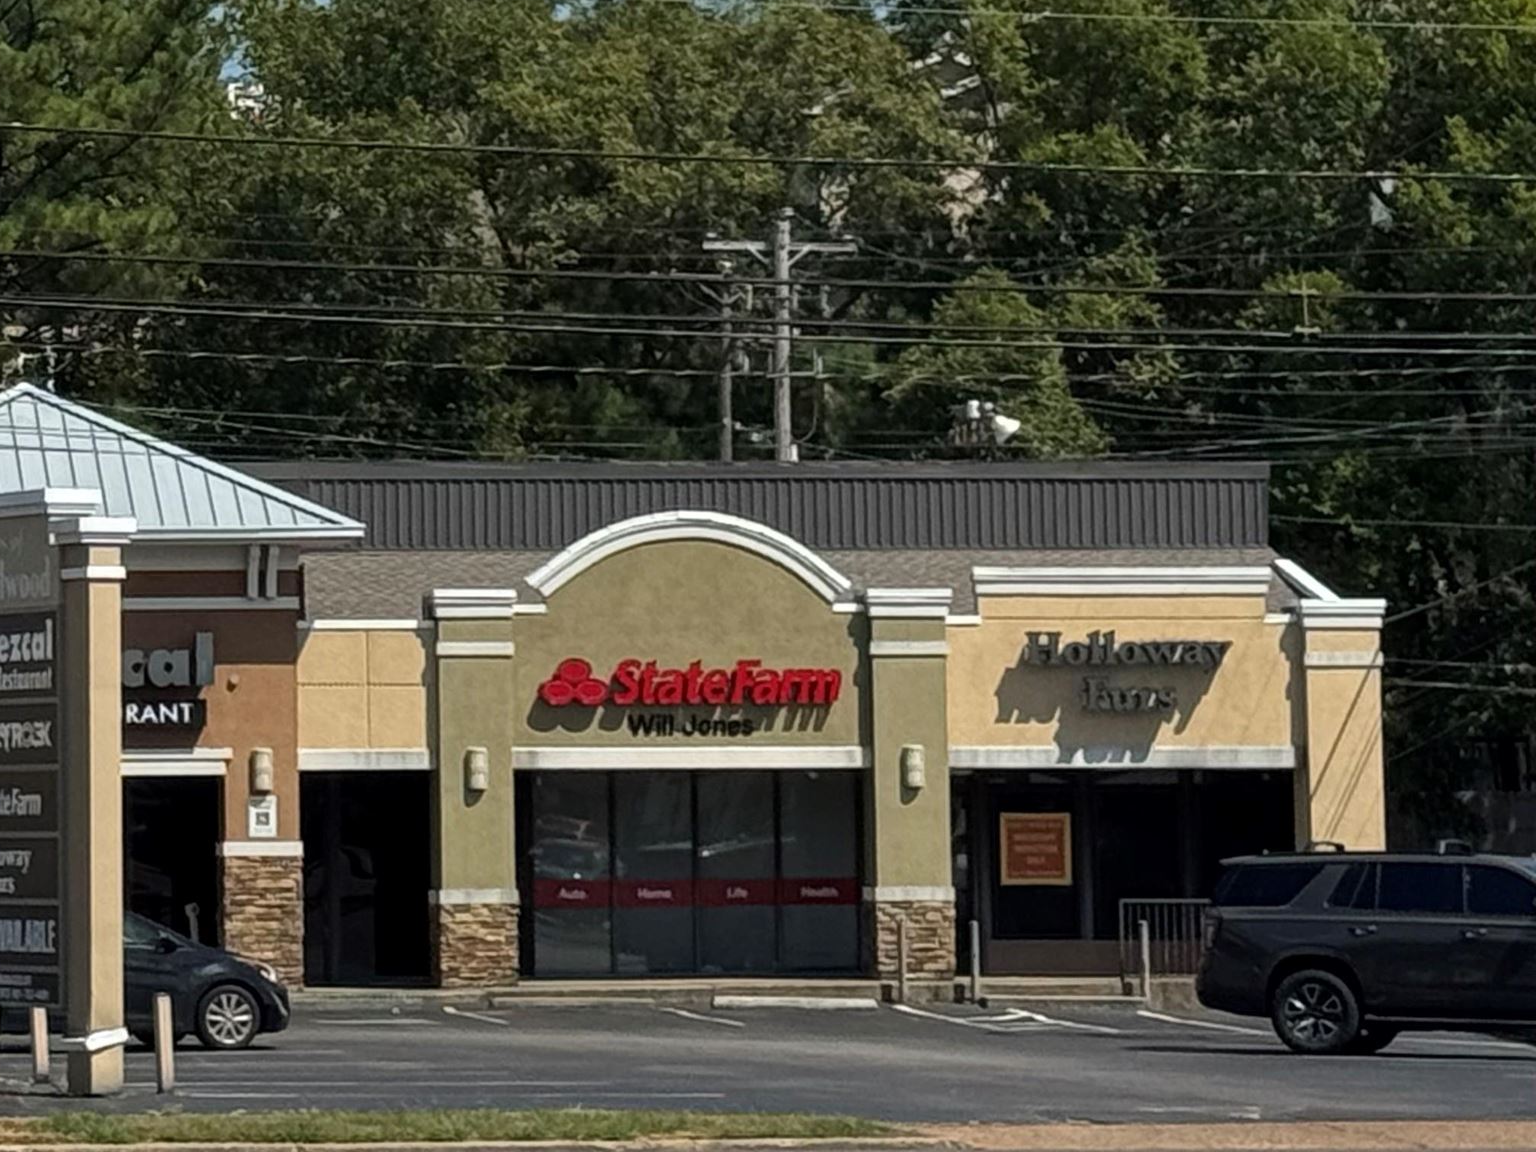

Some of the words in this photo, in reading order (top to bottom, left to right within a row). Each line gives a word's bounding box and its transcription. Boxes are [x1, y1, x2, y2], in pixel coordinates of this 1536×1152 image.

[1024, 629, 1233, 675] Holloway
[1079, 676, 1177, 714] Furs
[627, 714, 674, 738] Will
[682, 714, 755, 738] Jones
